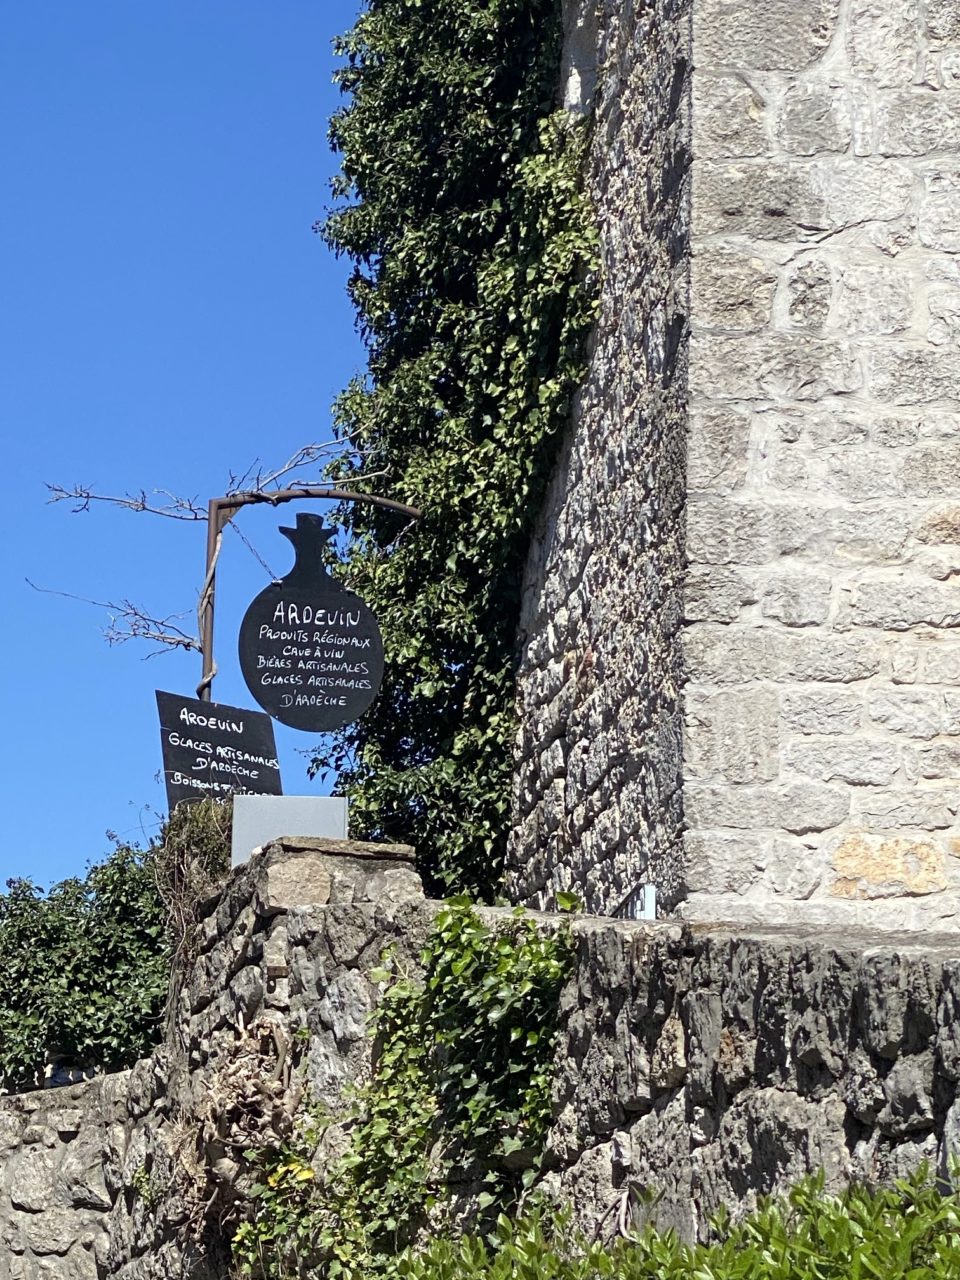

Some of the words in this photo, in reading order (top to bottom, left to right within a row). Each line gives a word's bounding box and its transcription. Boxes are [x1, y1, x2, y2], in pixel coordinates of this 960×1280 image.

[259, 625, 308, 643] PRODUITS
[282, 646, 312, 656] CAVE
[297, 660, 369, 675] ARTISANALES
[261, 673, 303, 685] GLACES
[307, 675, 372, 689] ARTISANALES
[168, 732, 213, 754] GLACES
[216, 746, 280, 770] ARTISANALES
